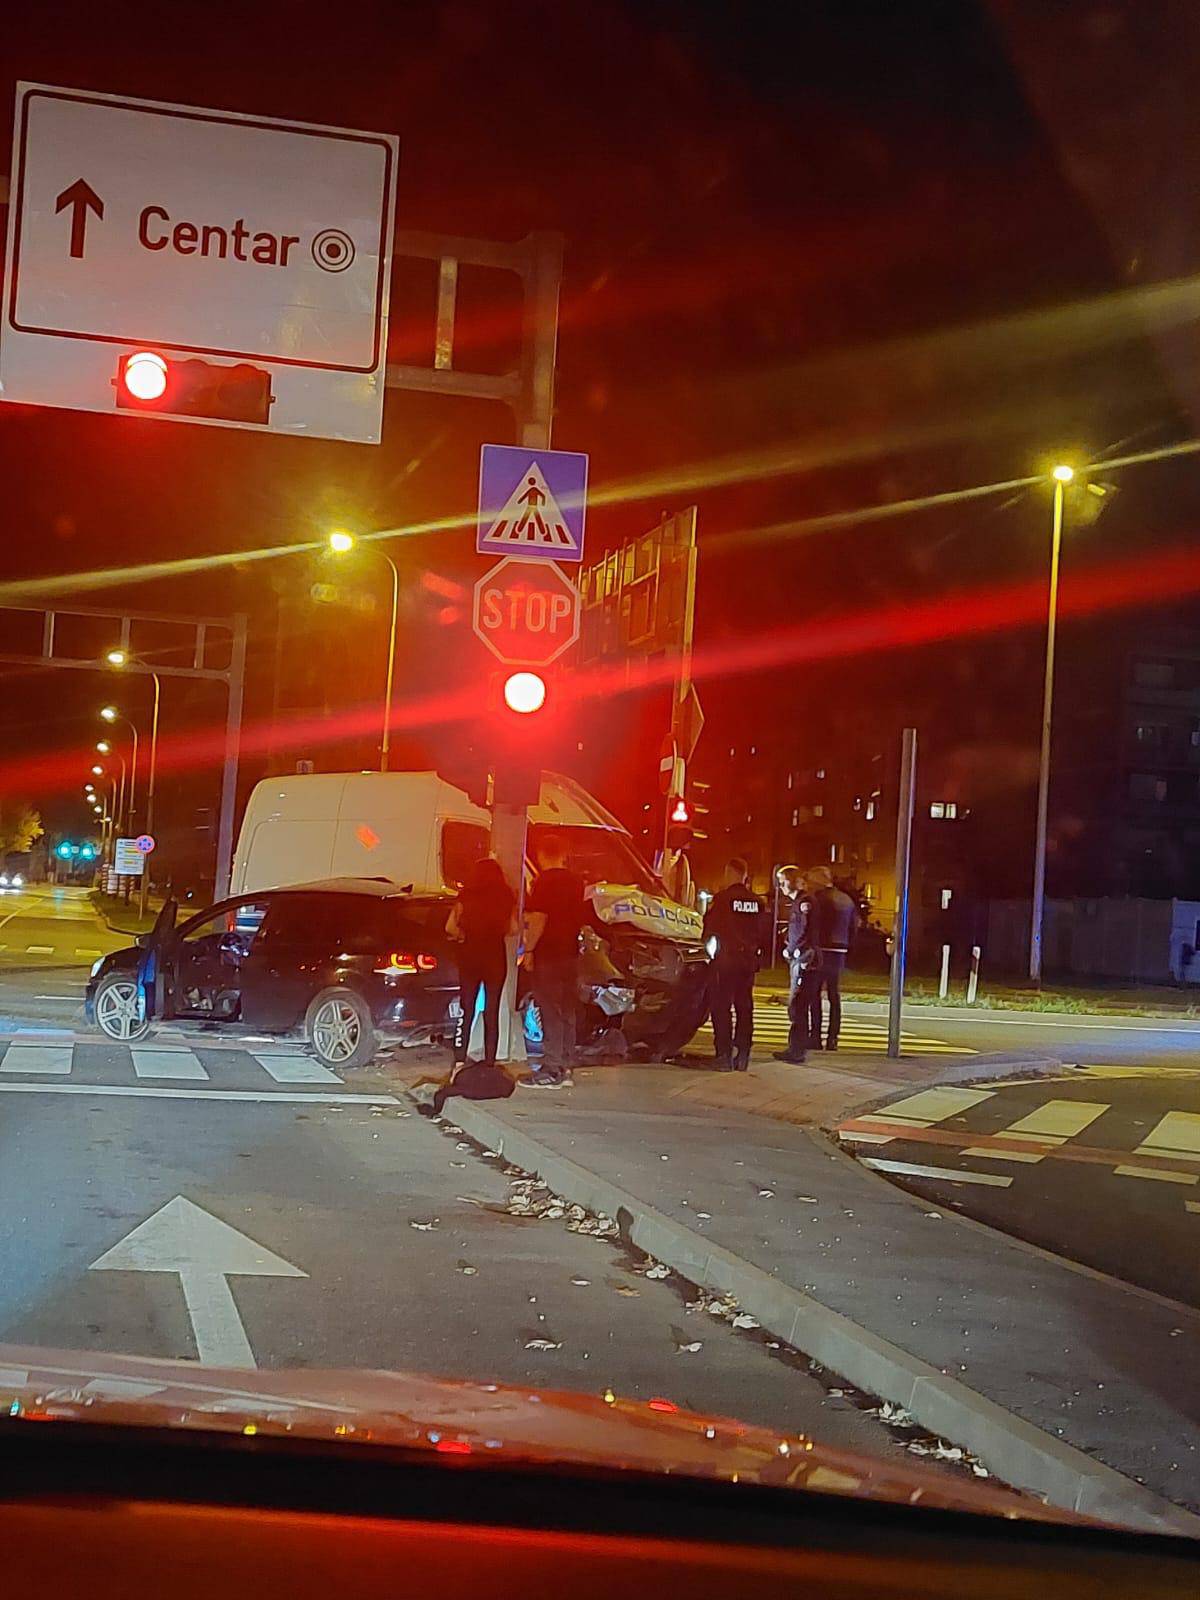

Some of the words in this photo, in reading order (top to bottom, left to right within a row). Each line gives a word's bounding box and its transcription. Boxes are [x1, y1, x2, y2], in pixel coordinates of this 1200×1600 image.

[138, 205, 300, 267] Centar
[482, 588, 571, 634] STOP
[614, 903, 703, 930] POLICIJA
